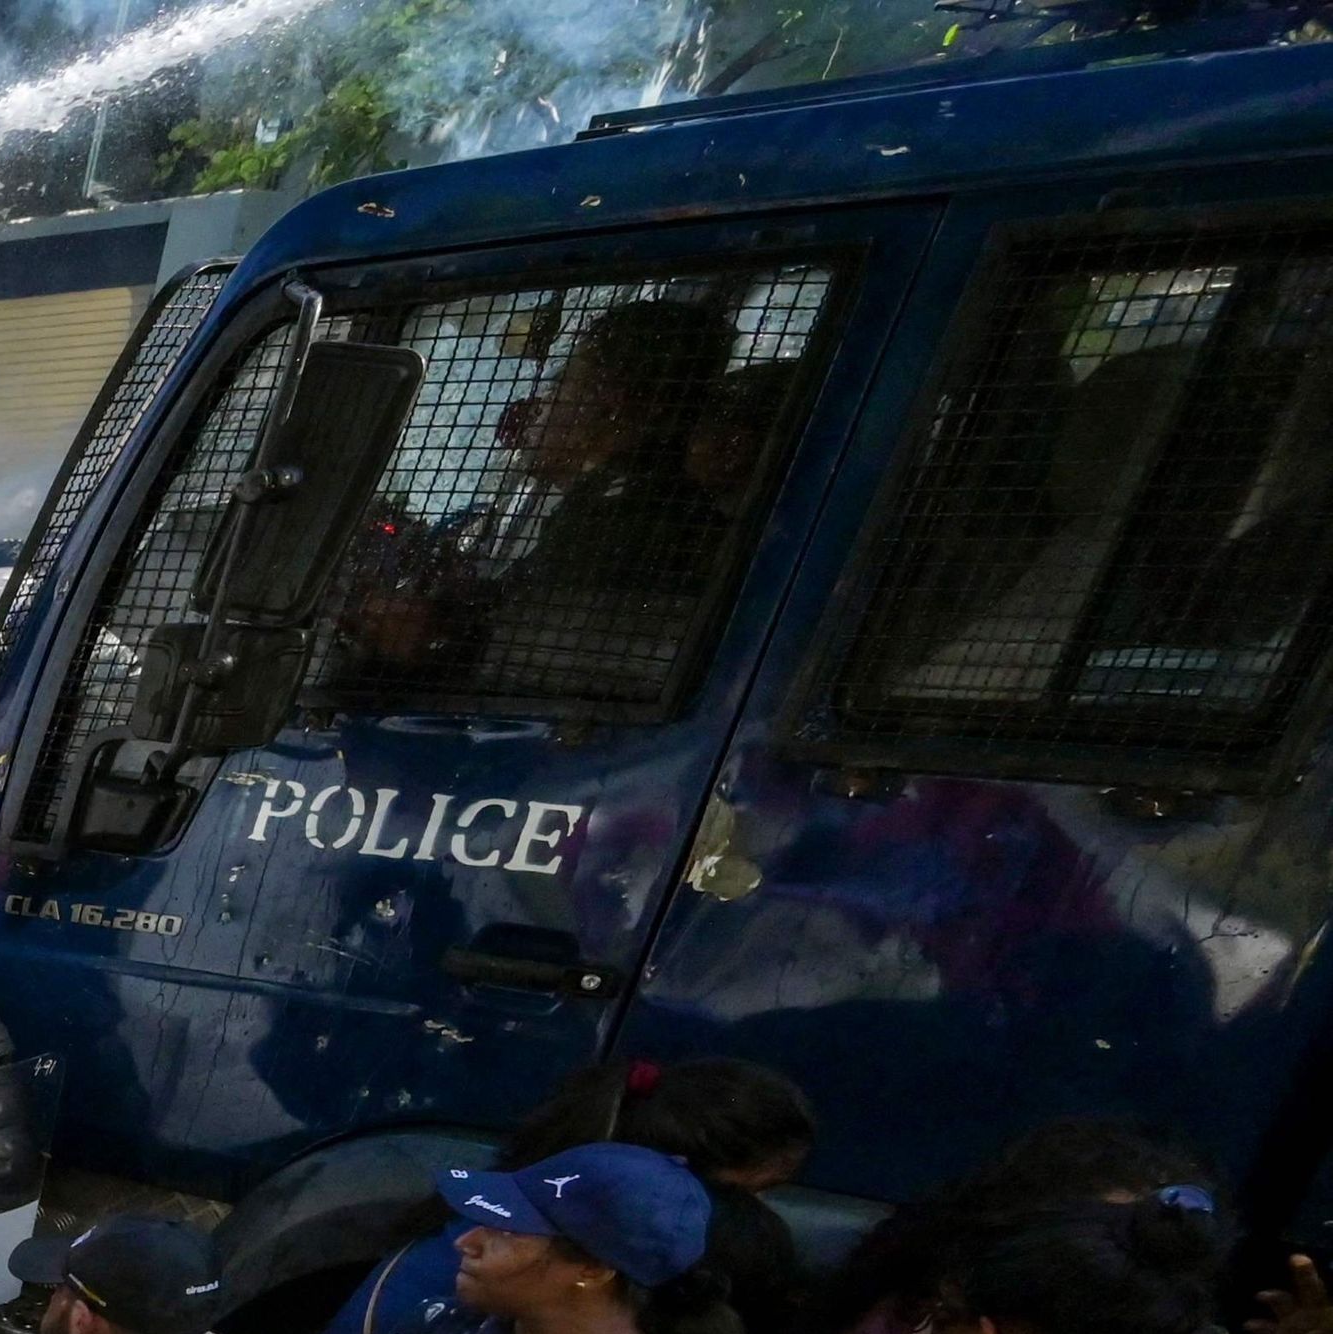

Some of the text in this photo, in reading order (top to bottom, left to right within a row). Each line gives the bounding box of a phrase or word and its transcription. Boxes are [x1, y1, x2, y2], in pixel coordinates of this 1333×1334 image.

[247, 779, 584, 875] POLICE
[4, 894, 184, 936] CLA 16.280
